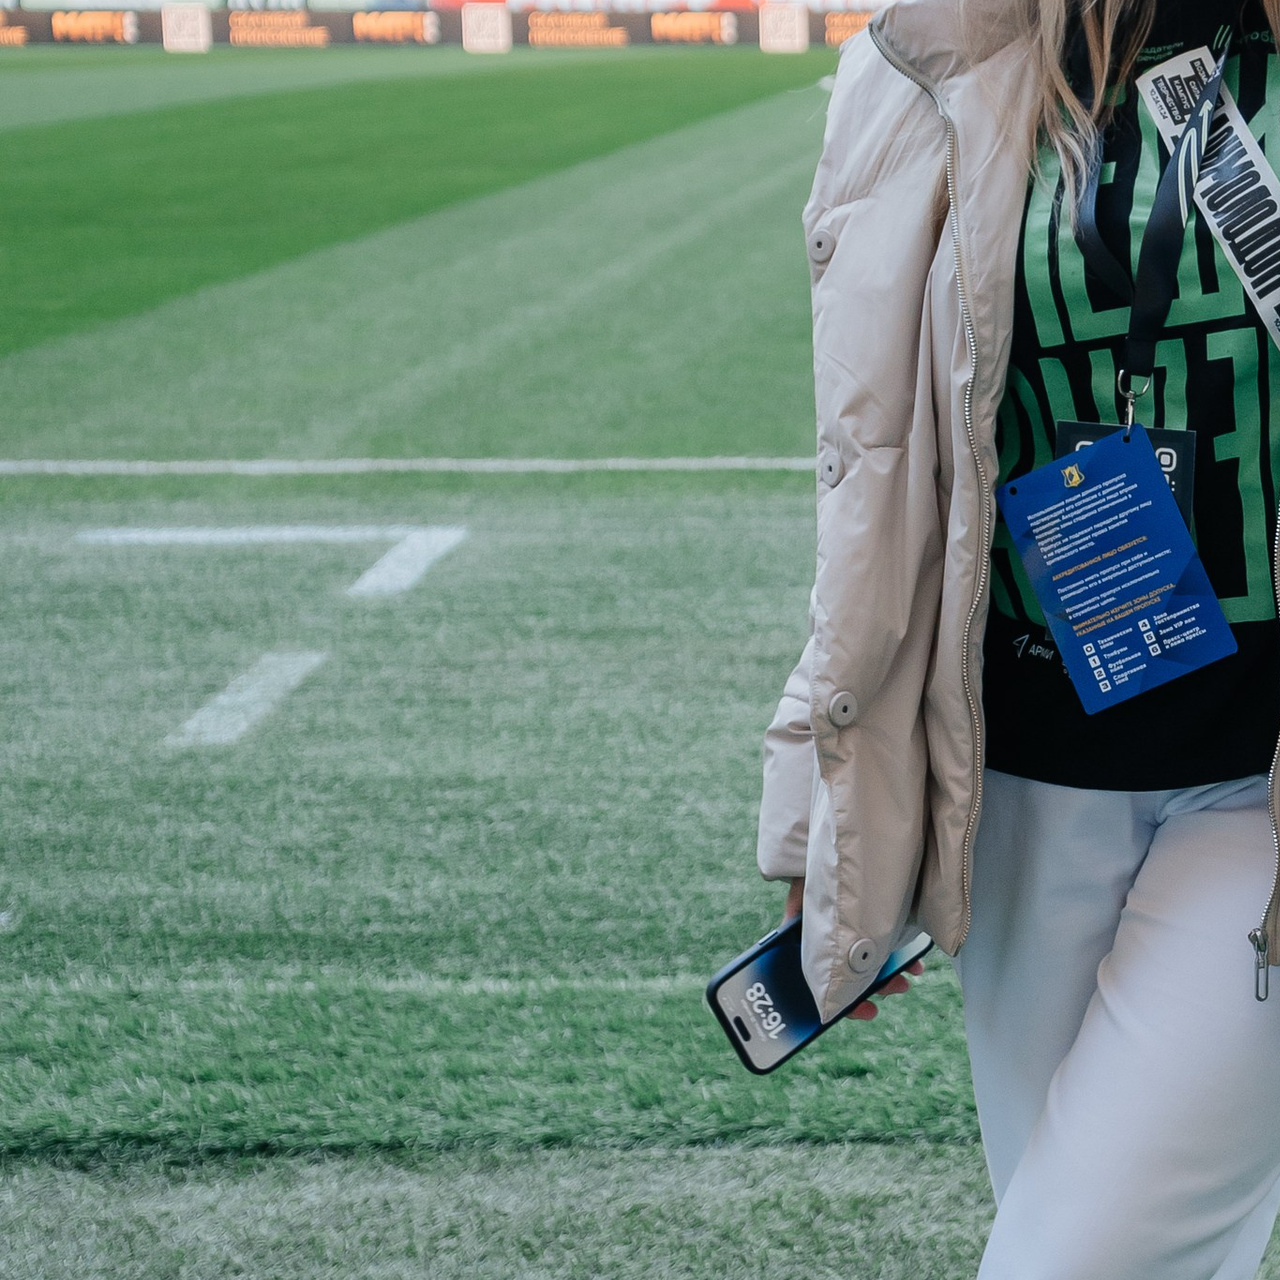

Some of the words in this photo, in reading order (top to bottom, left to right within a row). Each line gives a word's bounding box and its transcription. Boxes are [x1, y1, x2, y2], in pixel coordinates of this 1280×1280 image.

[1156, 78, 1182, 122] ТВОРЧЕСТВО
[1173, 79, 1191, 110] КАМПУС
[745, 982, 786, 1039] 16:28
